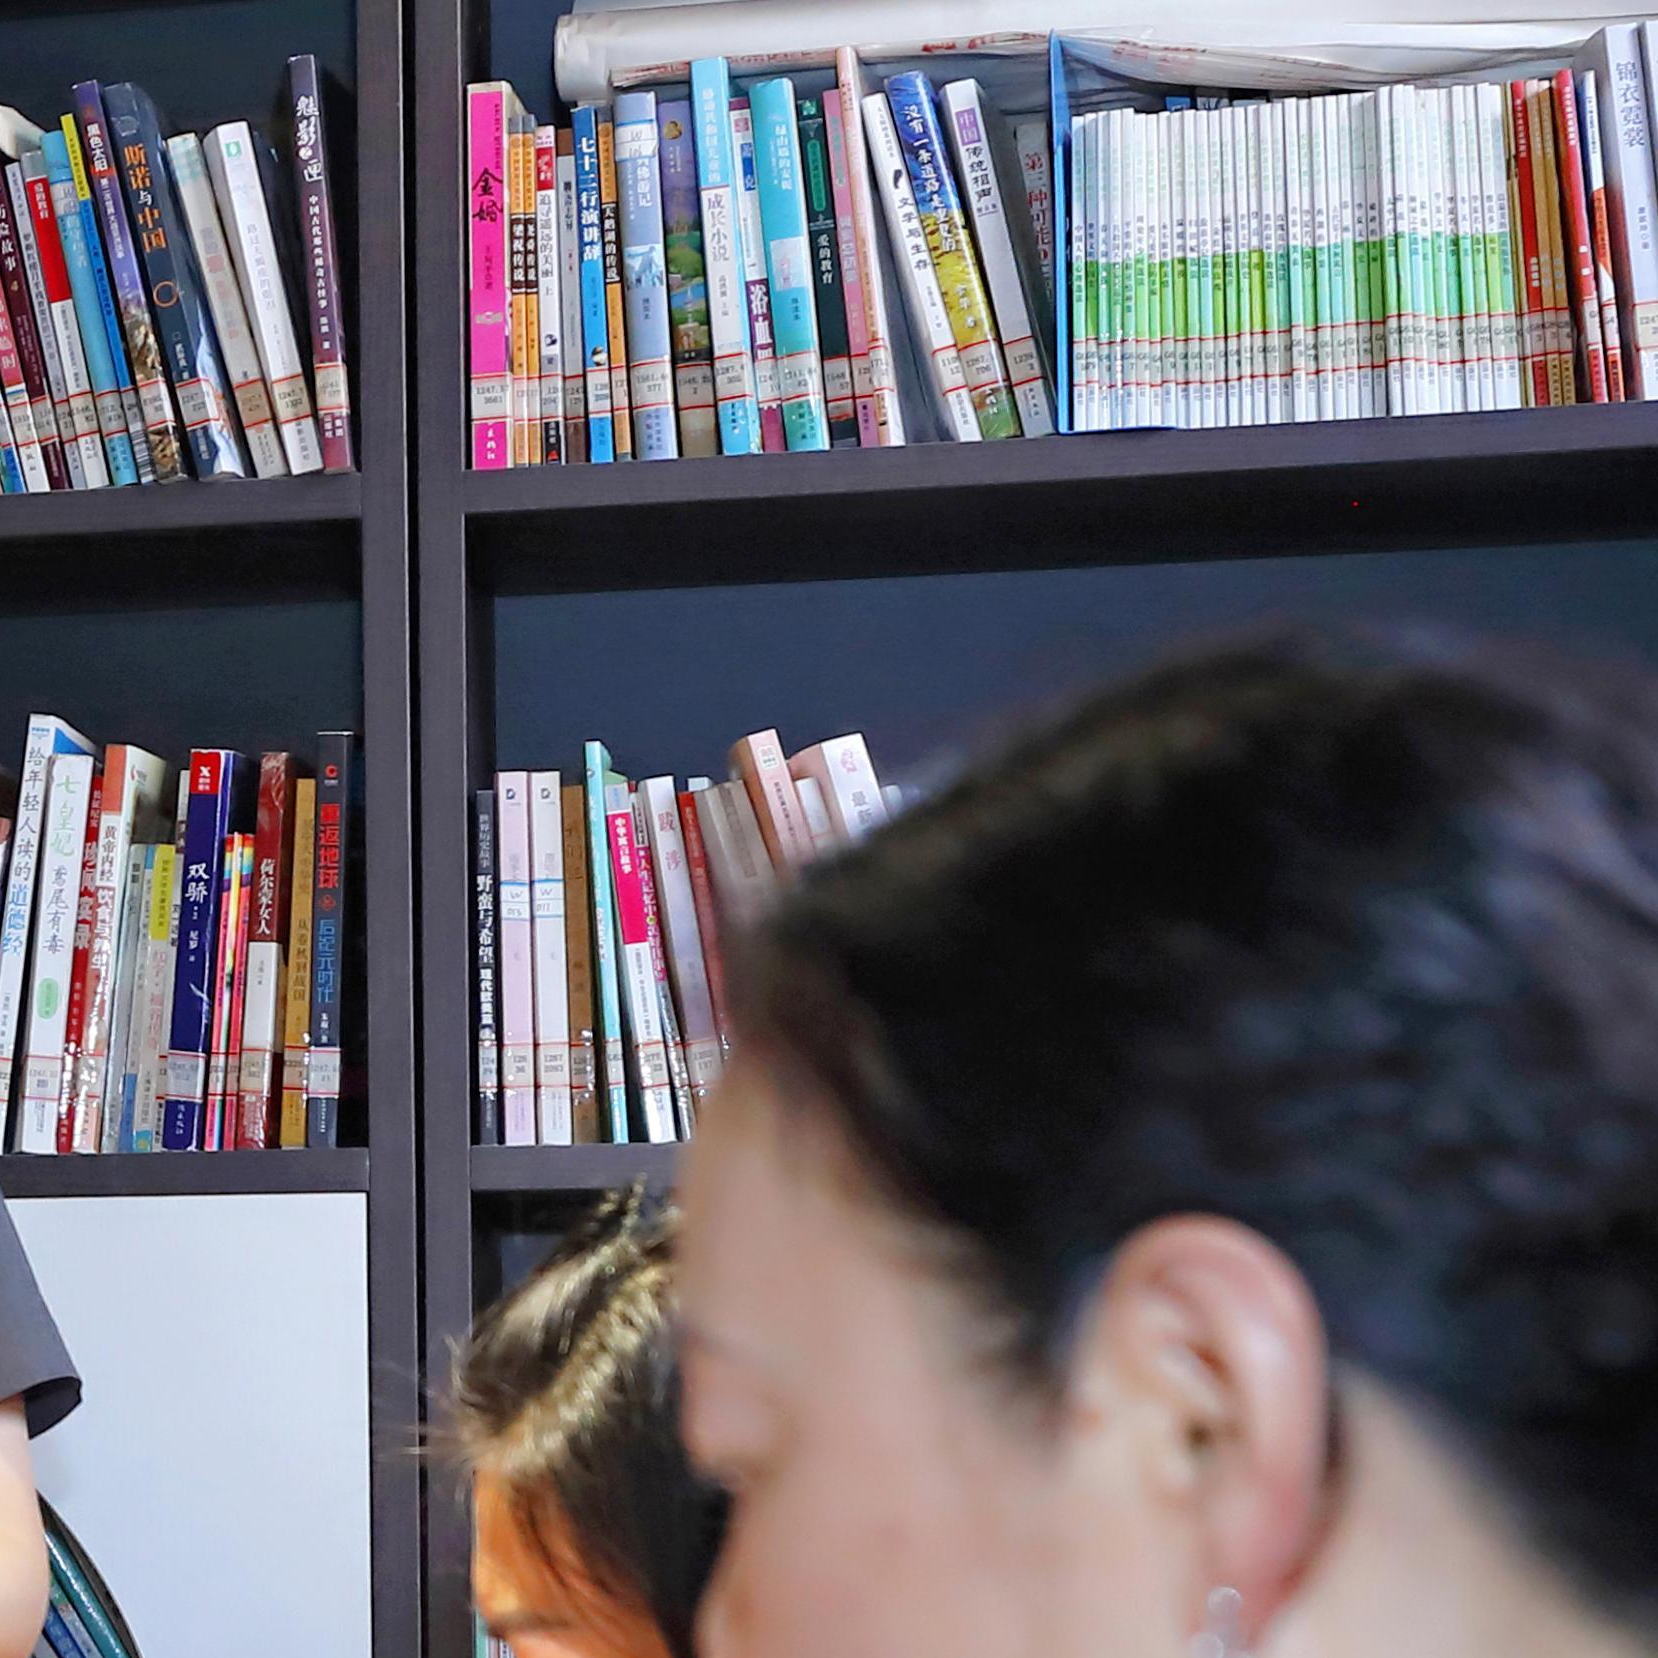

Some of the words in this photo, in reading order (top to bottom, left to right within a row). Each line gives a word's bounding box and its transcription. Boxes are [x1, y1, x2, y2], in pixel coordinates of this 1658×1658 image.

[123, 143, 168, 254] 斯诺与中国
[471, 167, 505, 225] 金婚
[576, 135, 602, 263] 七十二行演讲辞
[706, 192, 730, 263] 成长小说
[816, 232, 834, 285] 爱的教育
[898, 195, 932, 272] 文学与生存
[98, 825, 119, 883] 黄帝内经
[317, 802, 341, 889] 重返地球
